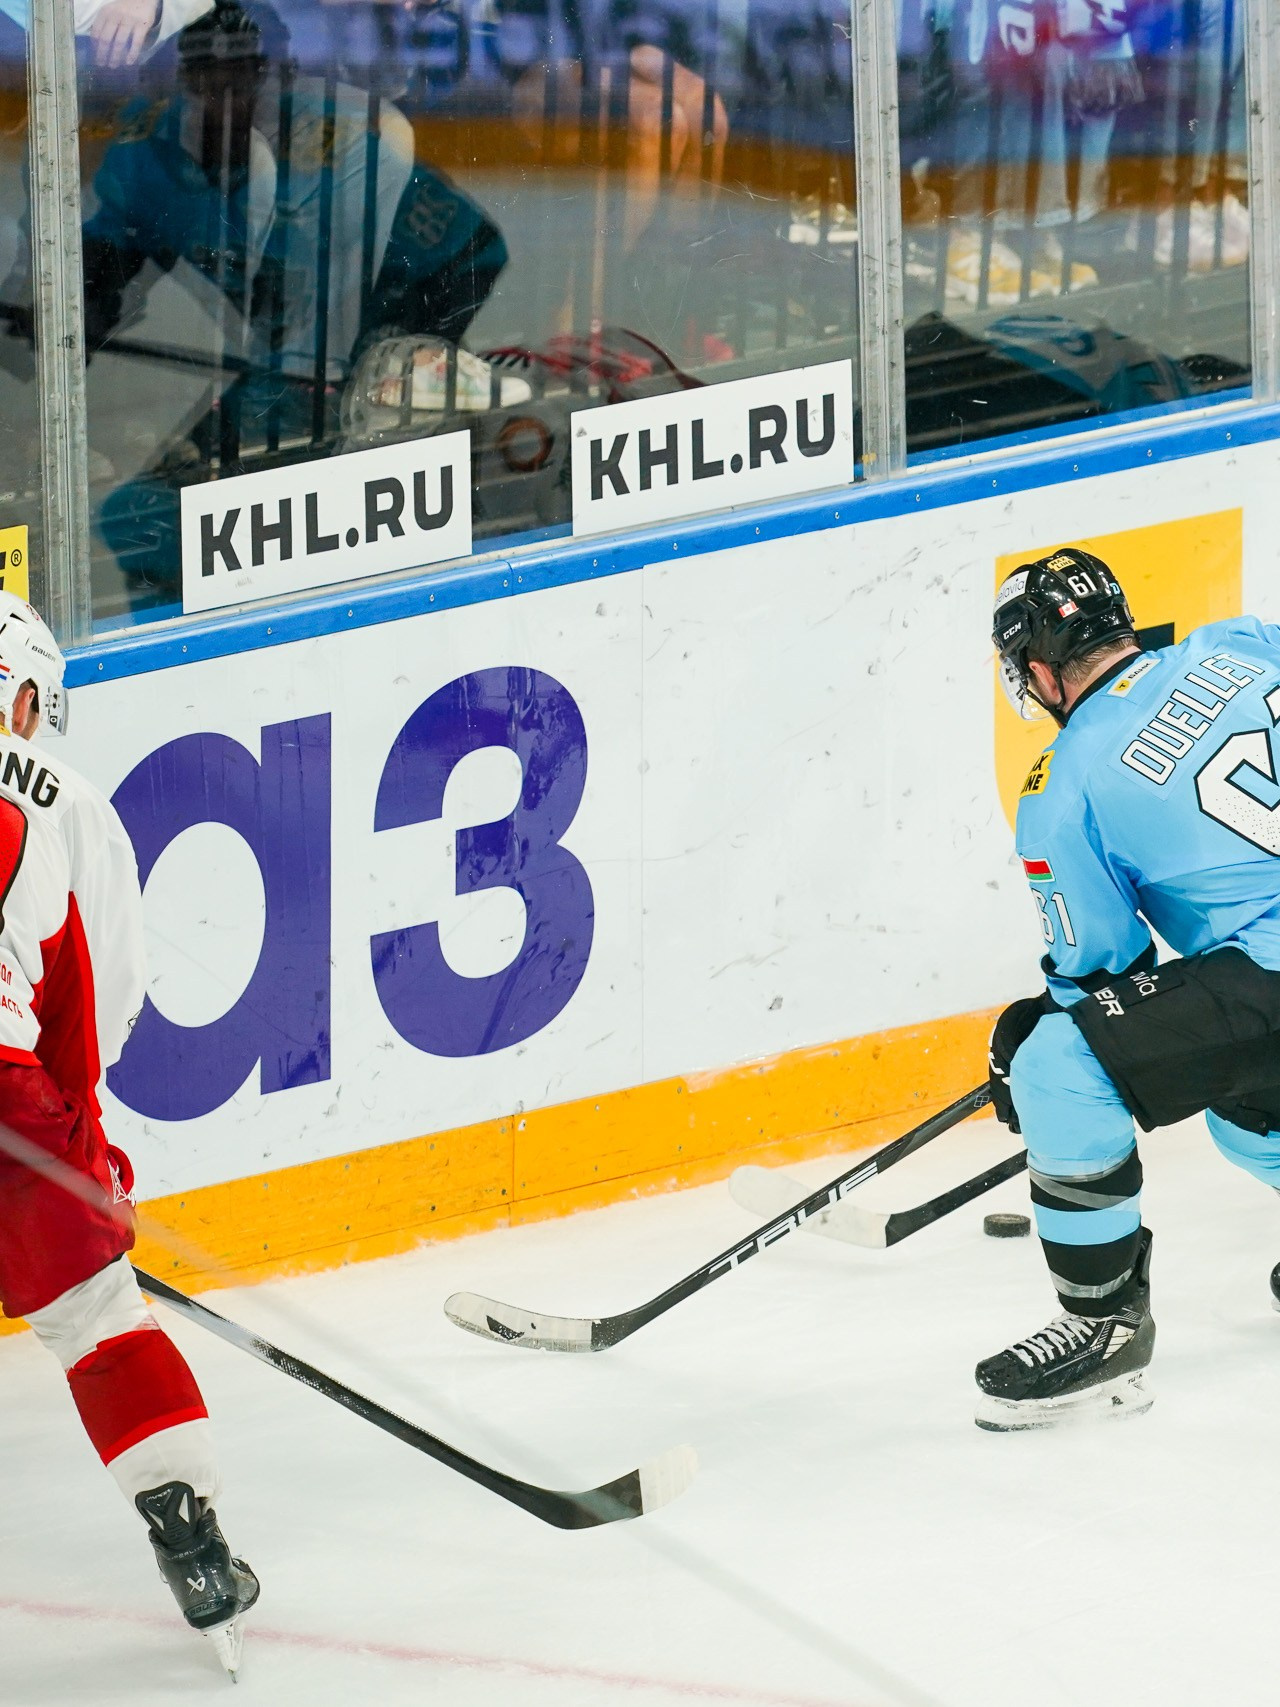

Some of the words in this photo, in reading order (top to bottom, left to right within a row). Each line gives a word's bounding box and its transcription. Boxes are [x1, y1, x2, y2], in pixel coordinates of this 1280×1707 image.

[589, 393, 837, 501] KHL.RU
[200, 464, 455, 577] KHL.RU
[1067, 571, 1097, 599] 61
[1003, 622, 1022, 640] CCM
[1120, 652, 1266, 786] OUELLET
[0, 750, 60, 808] NG
[1031, 887, 1077, 947] 61
[708, 1161, 879, 1275] TRUE
